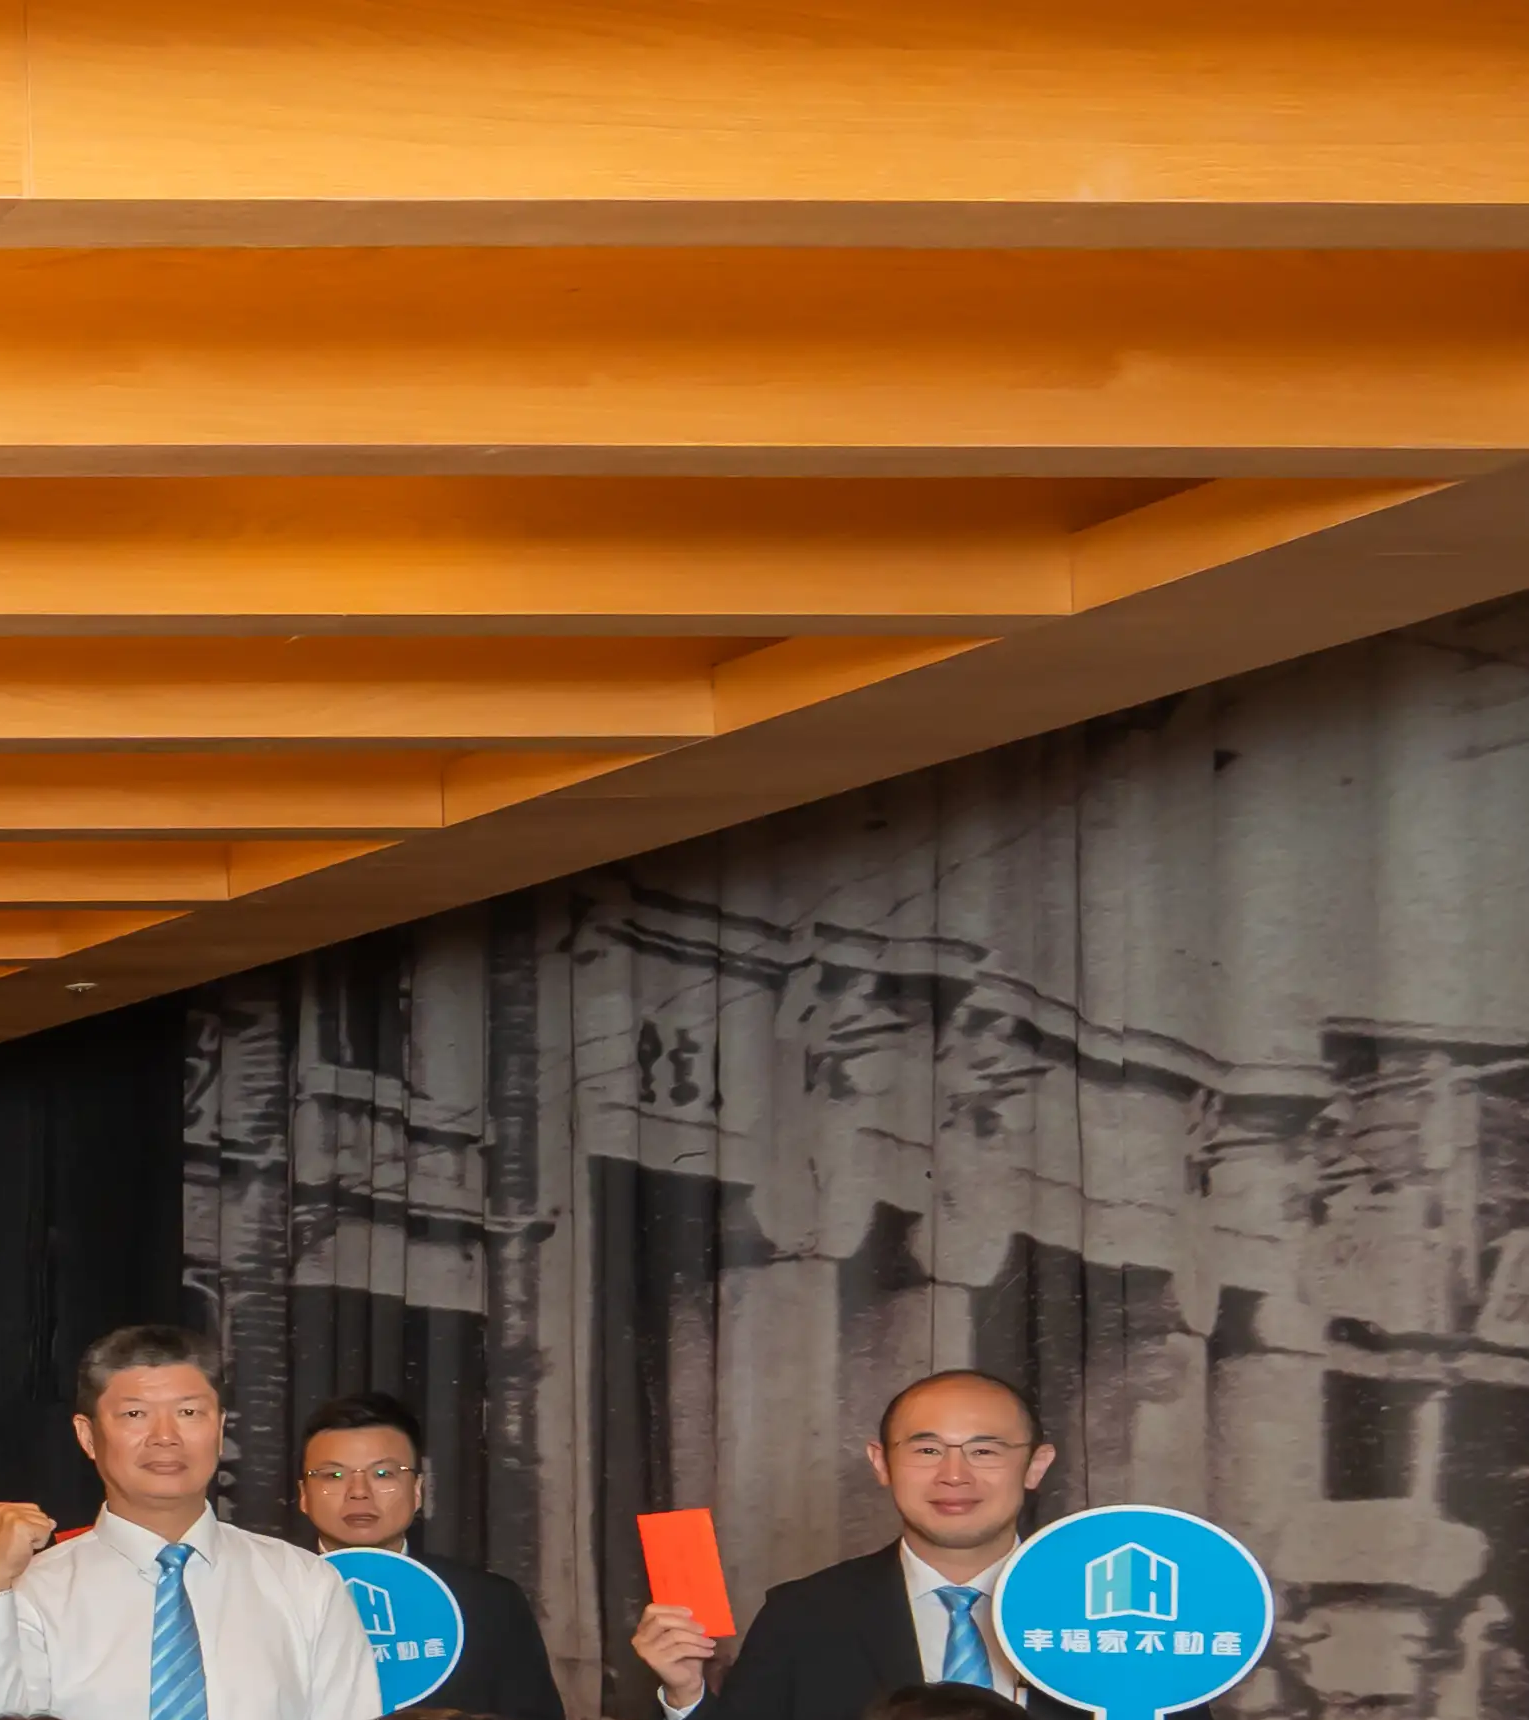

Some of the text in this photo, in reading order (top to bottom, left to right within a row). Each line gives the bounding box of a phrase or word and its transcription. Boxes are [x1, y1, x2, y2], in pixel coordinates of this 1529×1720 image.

[1023, 1628, 1243, 1657] 幸福家不動產
